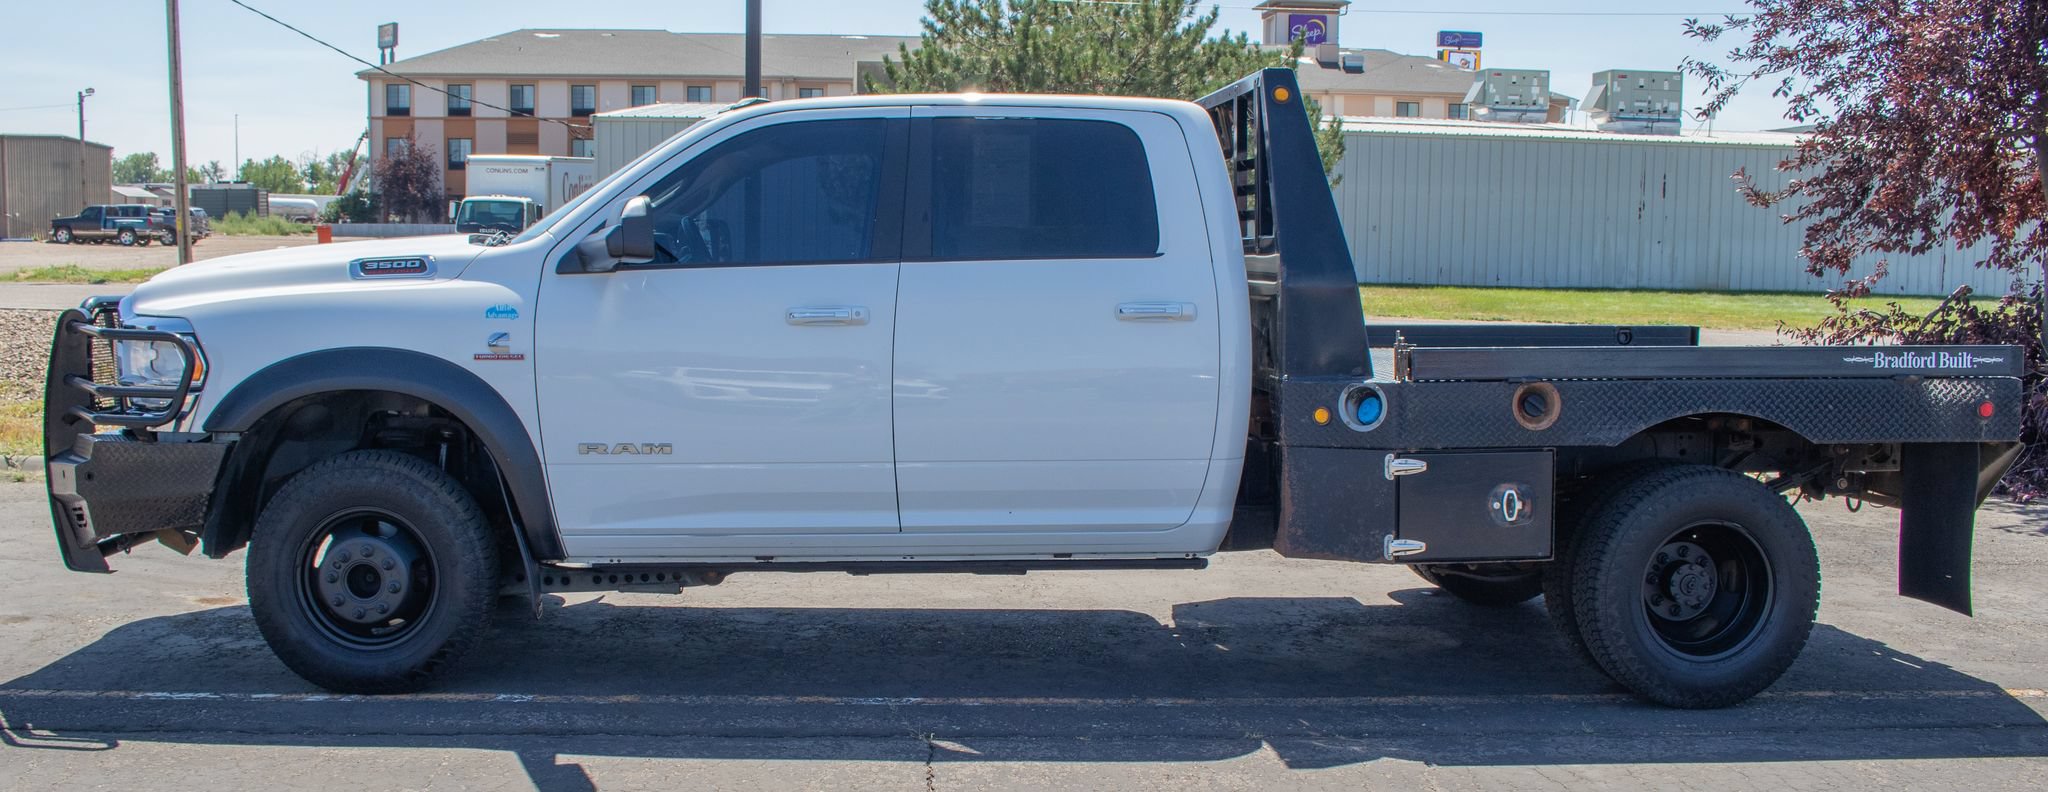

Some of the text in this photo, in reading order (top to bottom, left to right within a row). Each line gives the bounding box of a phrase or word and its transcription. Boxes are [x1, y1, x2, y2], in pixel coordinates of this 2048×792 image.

[365, 260, 420, 269] 3500
[1873, 352, 1936, 369] Bradford
[578, 443, 672, 454] RAM
